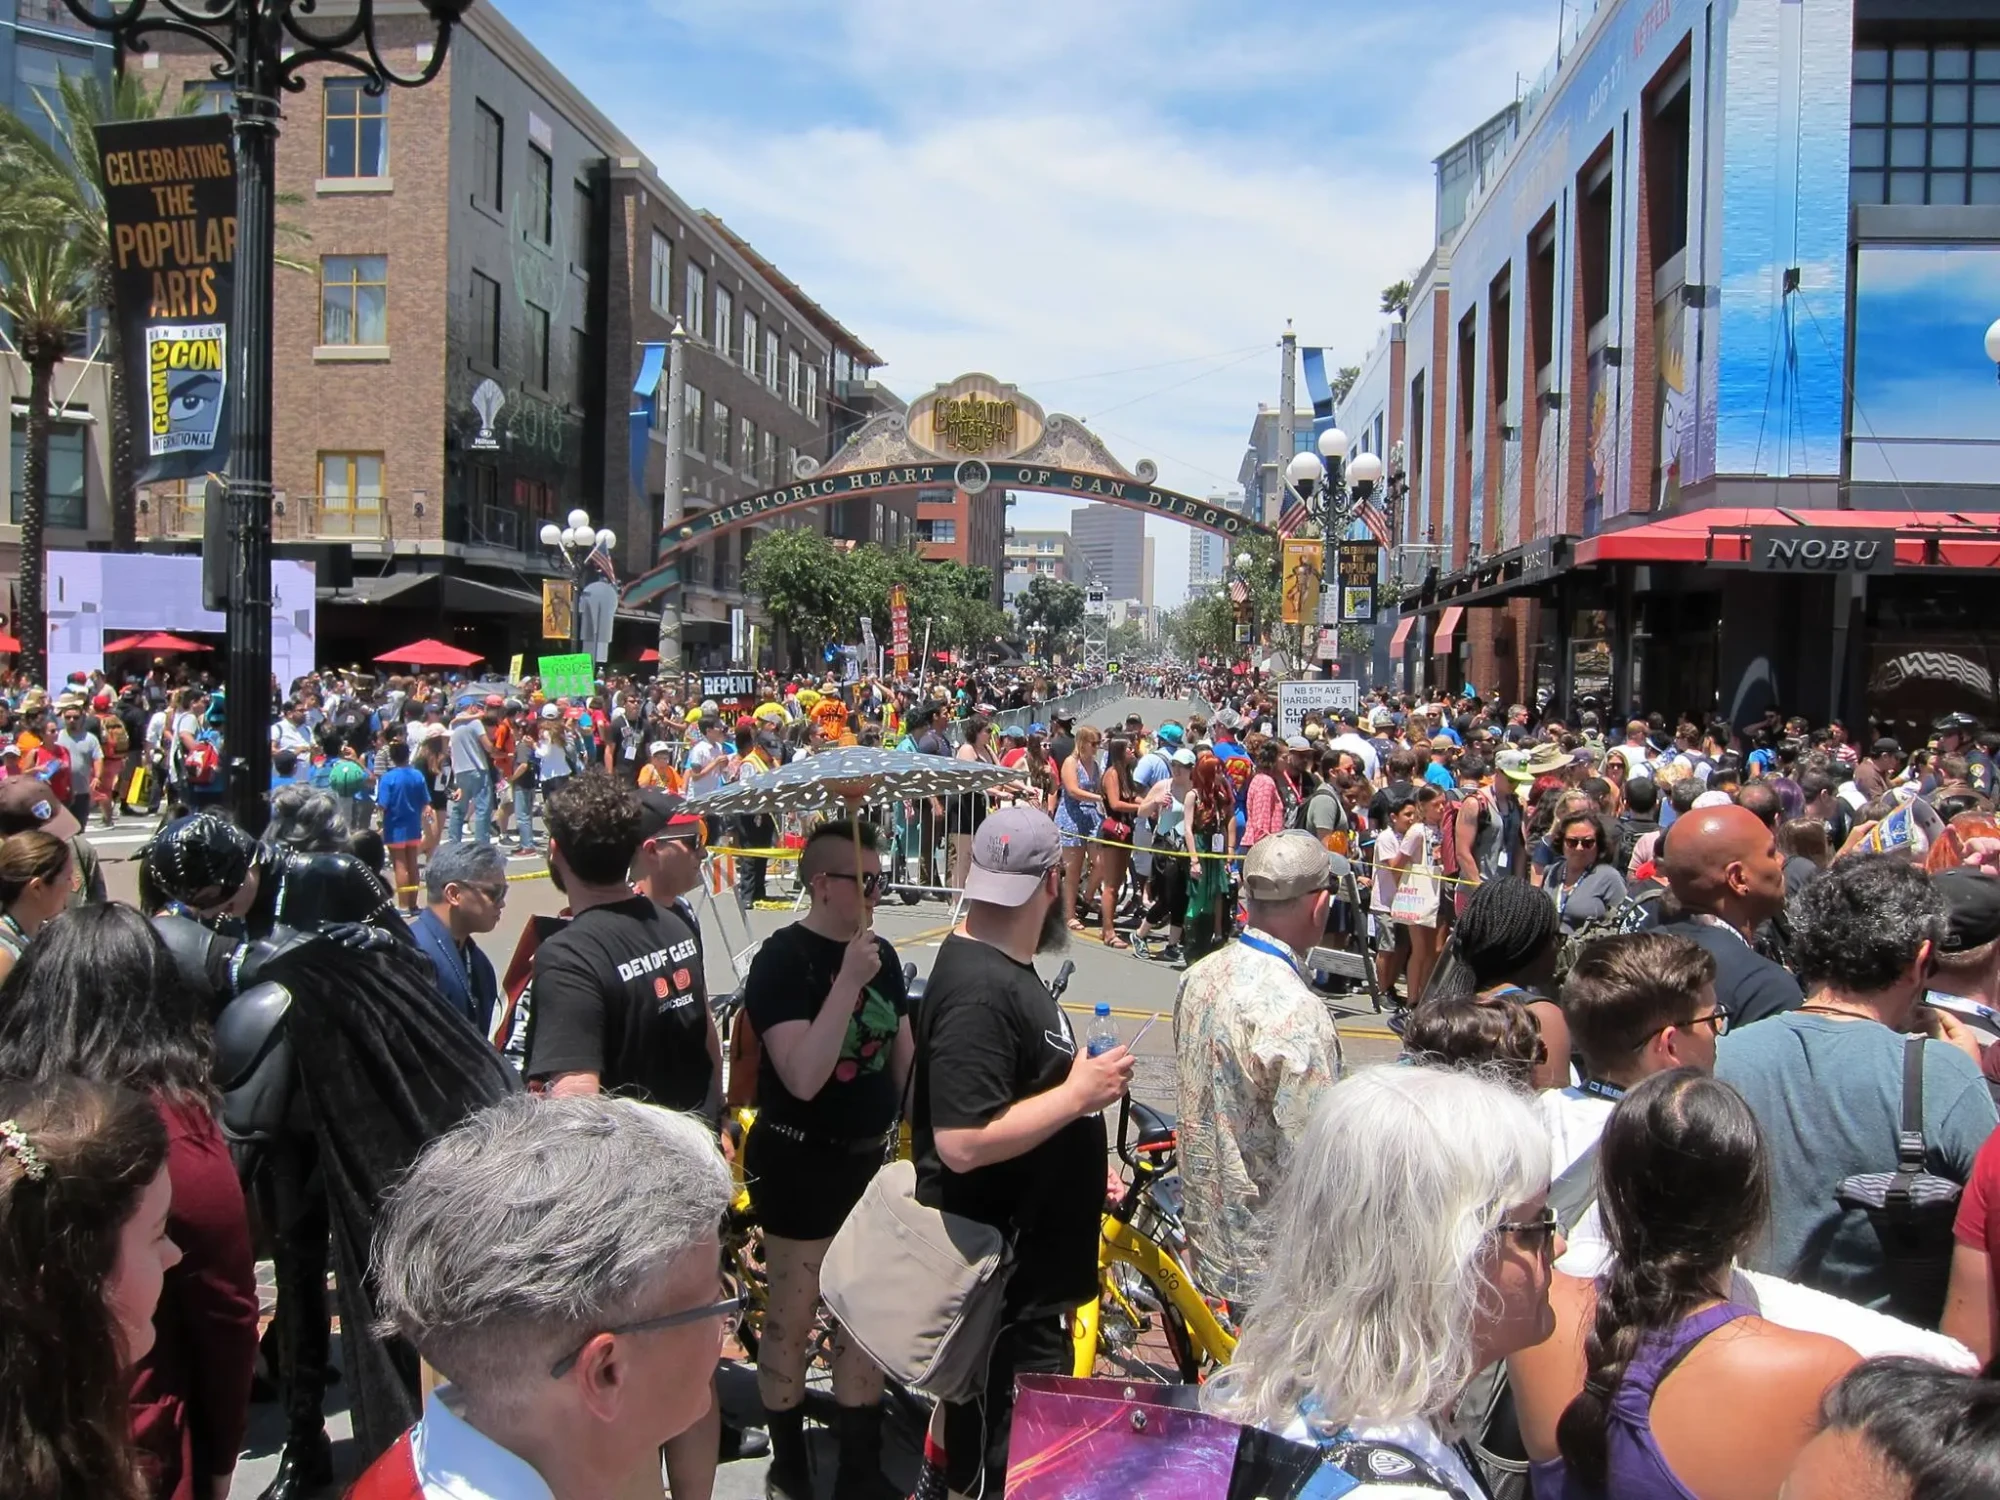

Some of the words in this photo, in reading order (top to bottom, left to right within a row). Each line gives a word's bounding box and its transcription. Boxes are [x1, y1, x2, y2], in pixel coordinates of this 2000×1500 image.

[105, 144, 231, 187] CELEBRATING
[151, 184, 198, 217] THE
[115, 216, 238, 270] POPULAR
[151, 267, 217, 317] ARTS
[182, 327, 222, 338] DIEGO
[169, 339, 222, 371] CON
[151, 340, 169, 434] COMIC
[152, 432, 212, 451] INTERNATIONAL
[709, 479, 835, 528] HISTORIC
[849, 467, 935, 489] HEART
[1018, 468, 1050, 485] OF
[1071, 475, 1126, 498] SAN
[1149, 491, 1241, 533] DIEGO
[1766, 538, 1881, 560] NOBU
[1340, 562, 1377, 574] POPULAR
[1347, 574, 1370, 586] ARTS
[703, 676, 754, 695] REPENT
[1333, 696, 1338, 704] J
[1341, 696, 1353, 704] ST
[617, 955, 653, 982] DEN
[650, 949, 668, 971] OF
[1158, 1268, 1179, 1290] ofo
